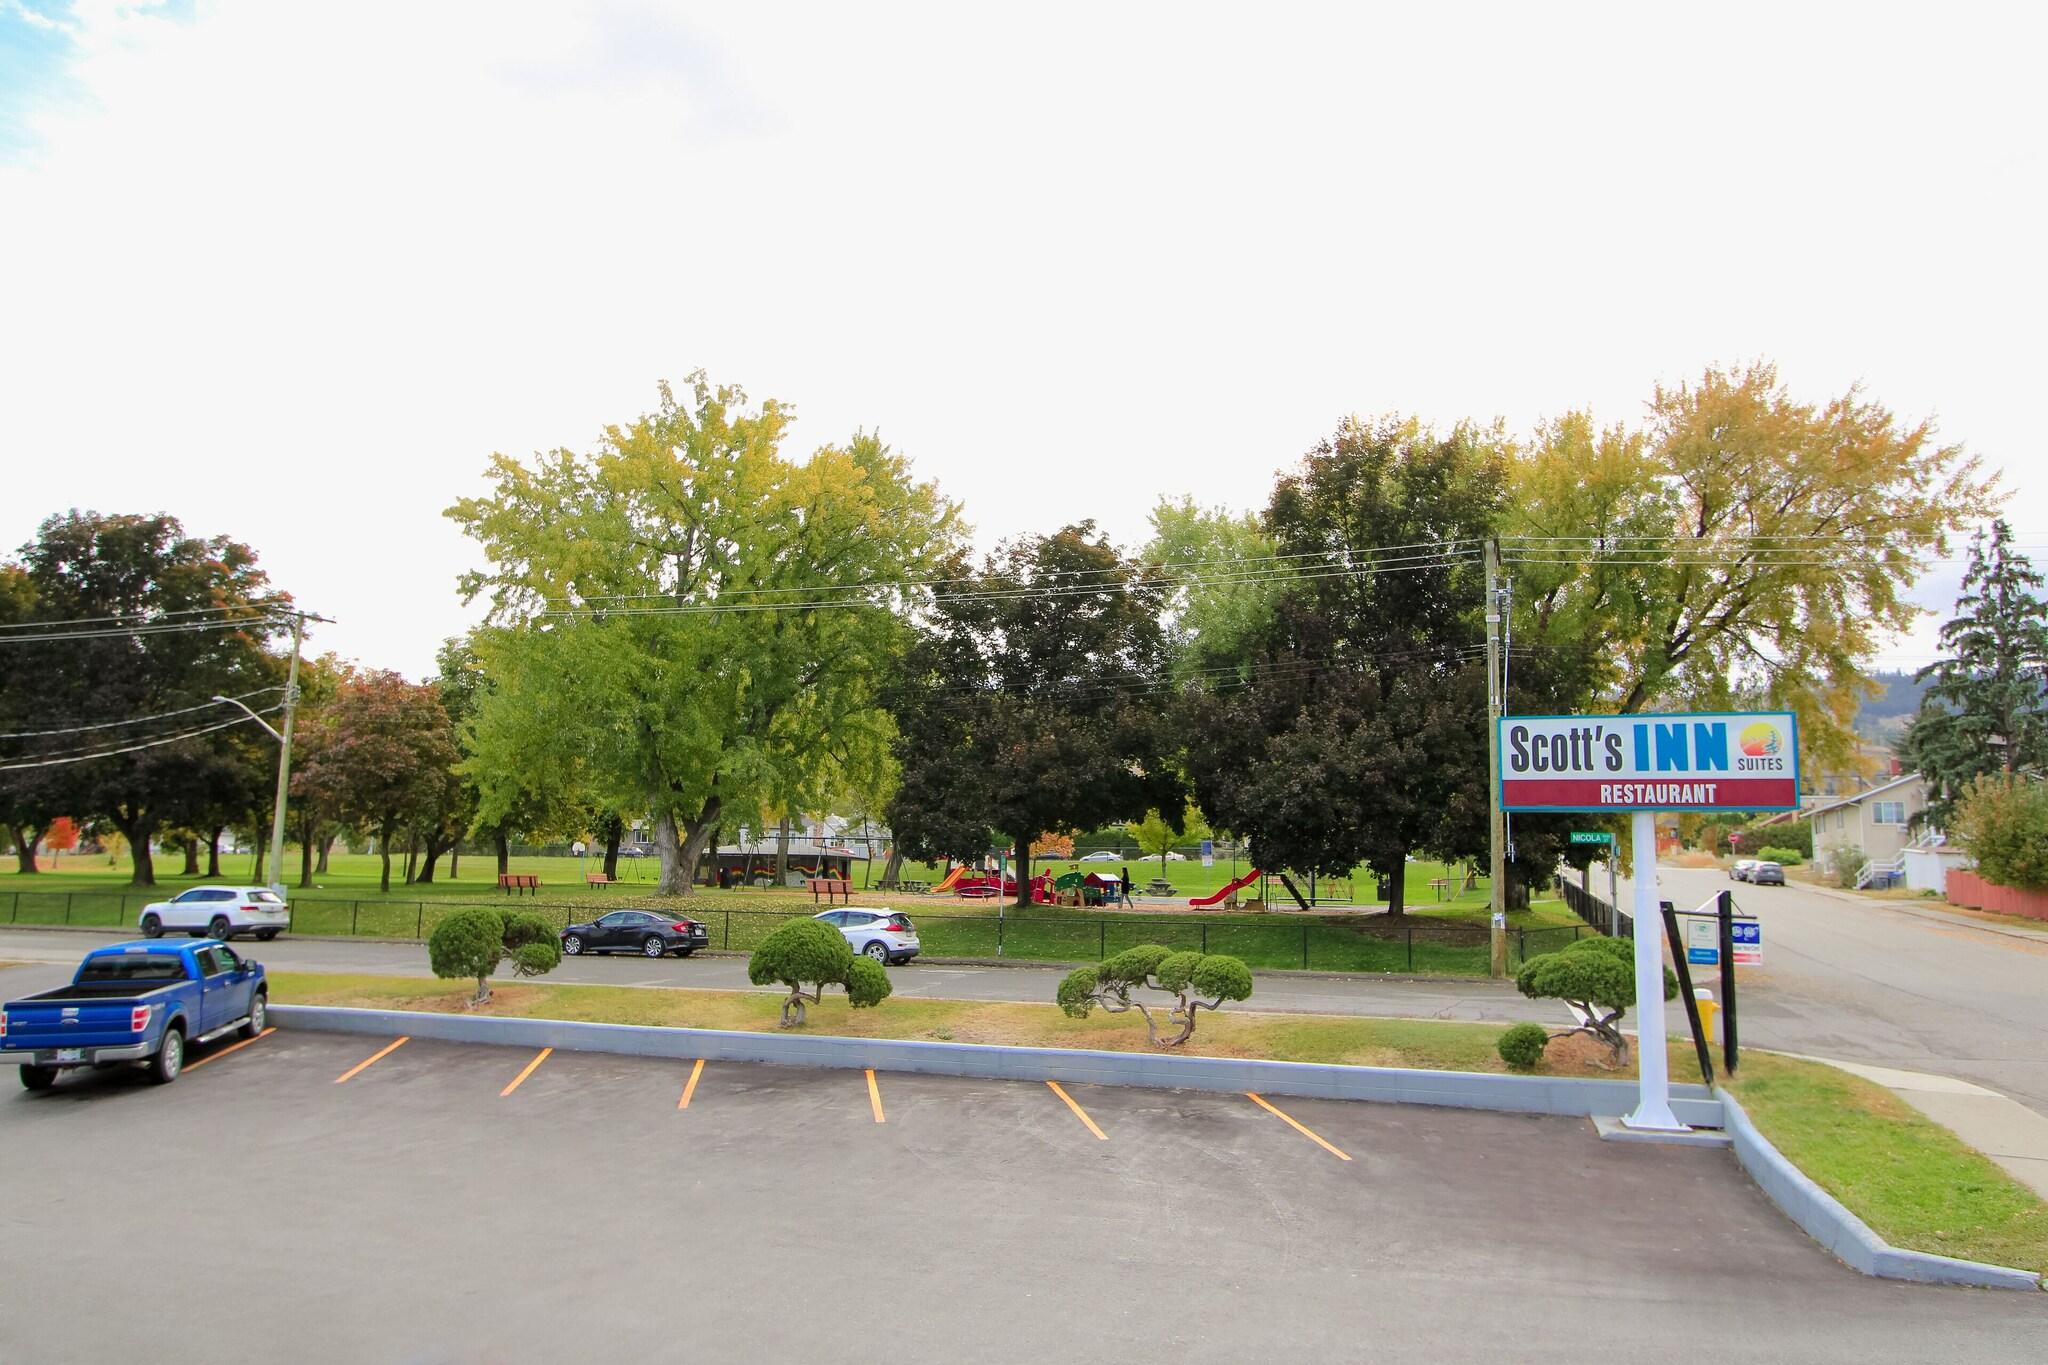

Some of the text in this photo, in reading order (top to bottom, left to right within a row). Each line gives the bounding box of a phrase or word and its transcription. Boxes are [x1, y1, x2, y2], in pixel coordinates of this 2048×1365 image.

[1510, 722, 1729, 772] Scott's INN
[1738, 757, 1783, 771] SUITES
[1600, 784, 1717, 804] RESTAURANT
[1572, 834, 1601, 842] NICOLA
